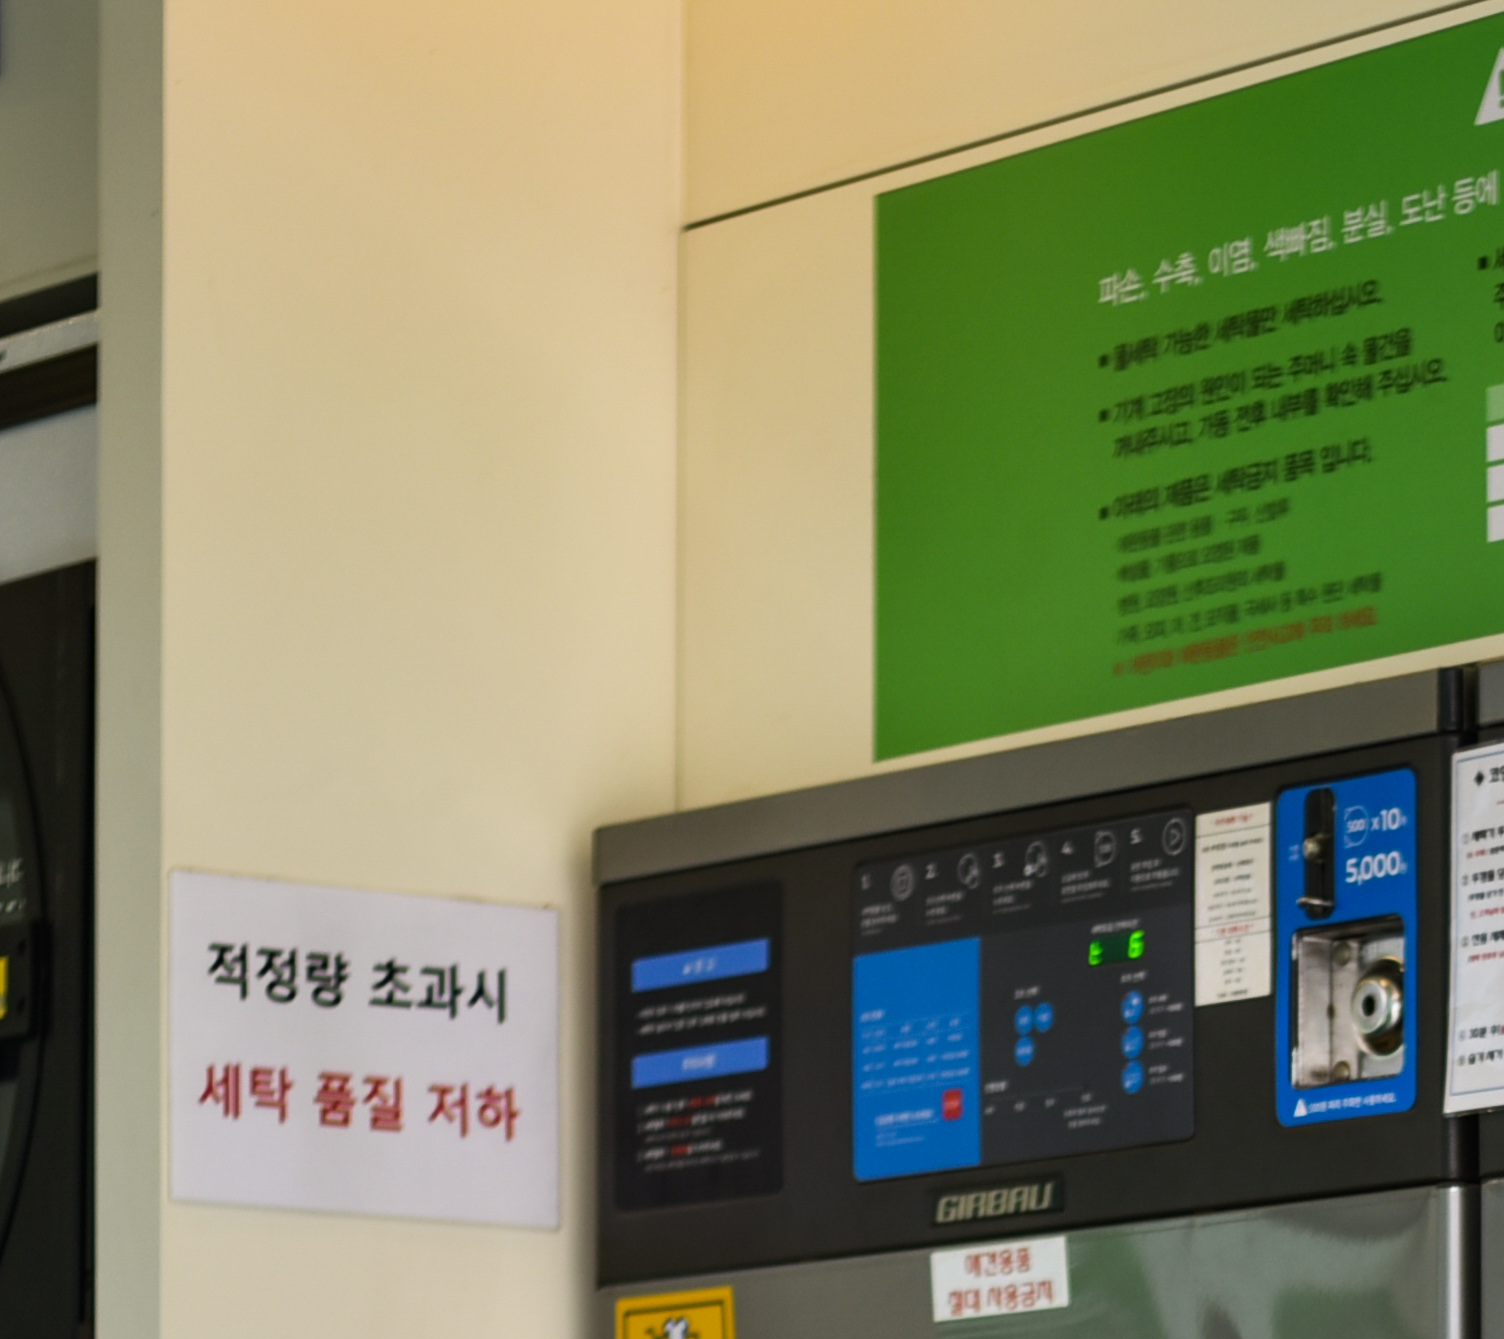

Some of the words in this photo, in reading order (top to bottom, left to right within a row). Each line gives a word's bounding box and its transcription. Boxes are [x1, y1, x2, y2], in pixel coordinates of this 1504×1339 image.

[1097, 268, 1149, 306] 파손,
[1151, 251, 1203, 293] 수축,
[1208, 236, 1258, 277] 이염,
[1263, 215, 1337, 262] 색빠짐,
[1340, 200, 1394, 245] 분실,
[1399, 184, 1448, 226] 도난
[1451, 169, 1499, 215] 등에
[208, 942, 349, 1009] 적정량
[369, 958, 507, 1025] 초과시
[198, 1062, 294, 1125] 세탁
[313, 1070, 403, 1133] 품질
[427, 1082, 520, 1142] 저하
